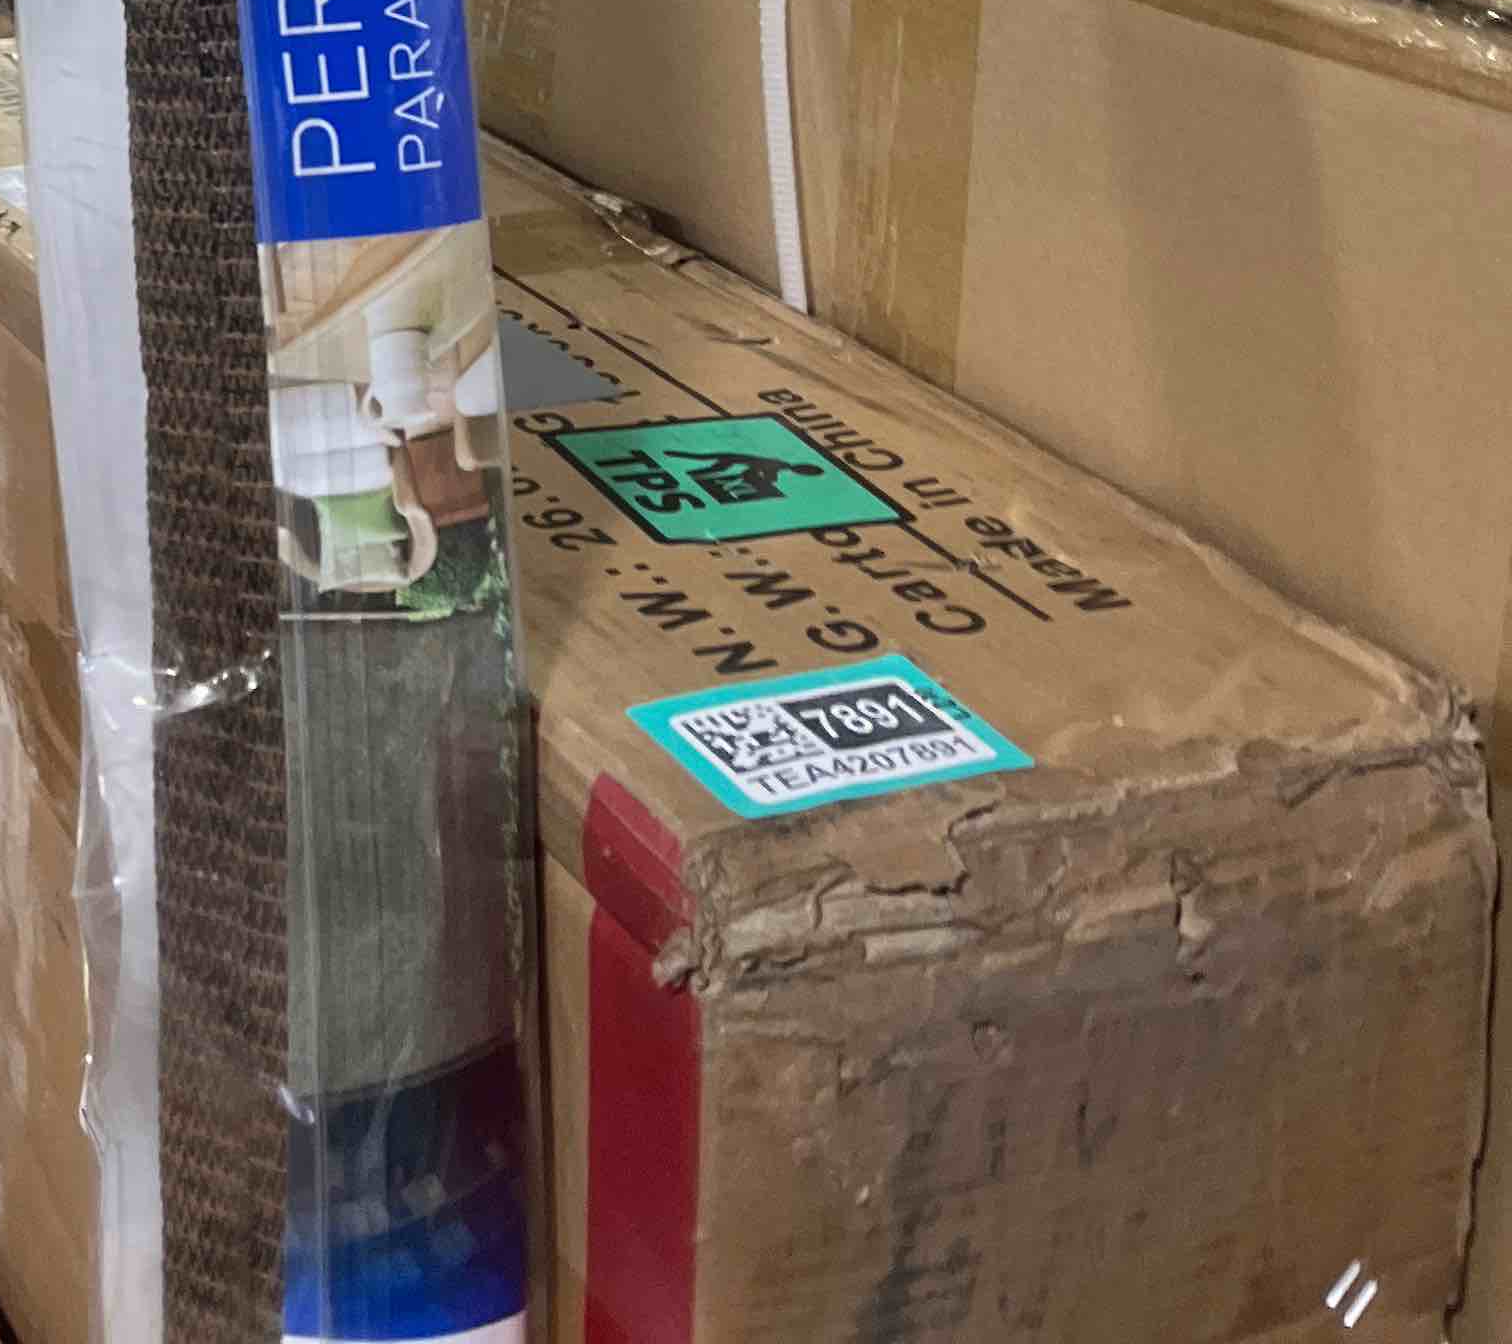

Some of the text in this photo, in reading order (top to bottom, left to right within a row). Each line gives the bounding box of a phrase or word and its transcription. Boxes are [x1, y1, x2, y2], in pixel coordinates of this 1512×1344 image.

[758, 388, 1132, 612] Made in China
[810, 527, 987, 635] Carto
[800, 692, 926, 740] 7891
[747, 735, 978, 796] TEA4207891
